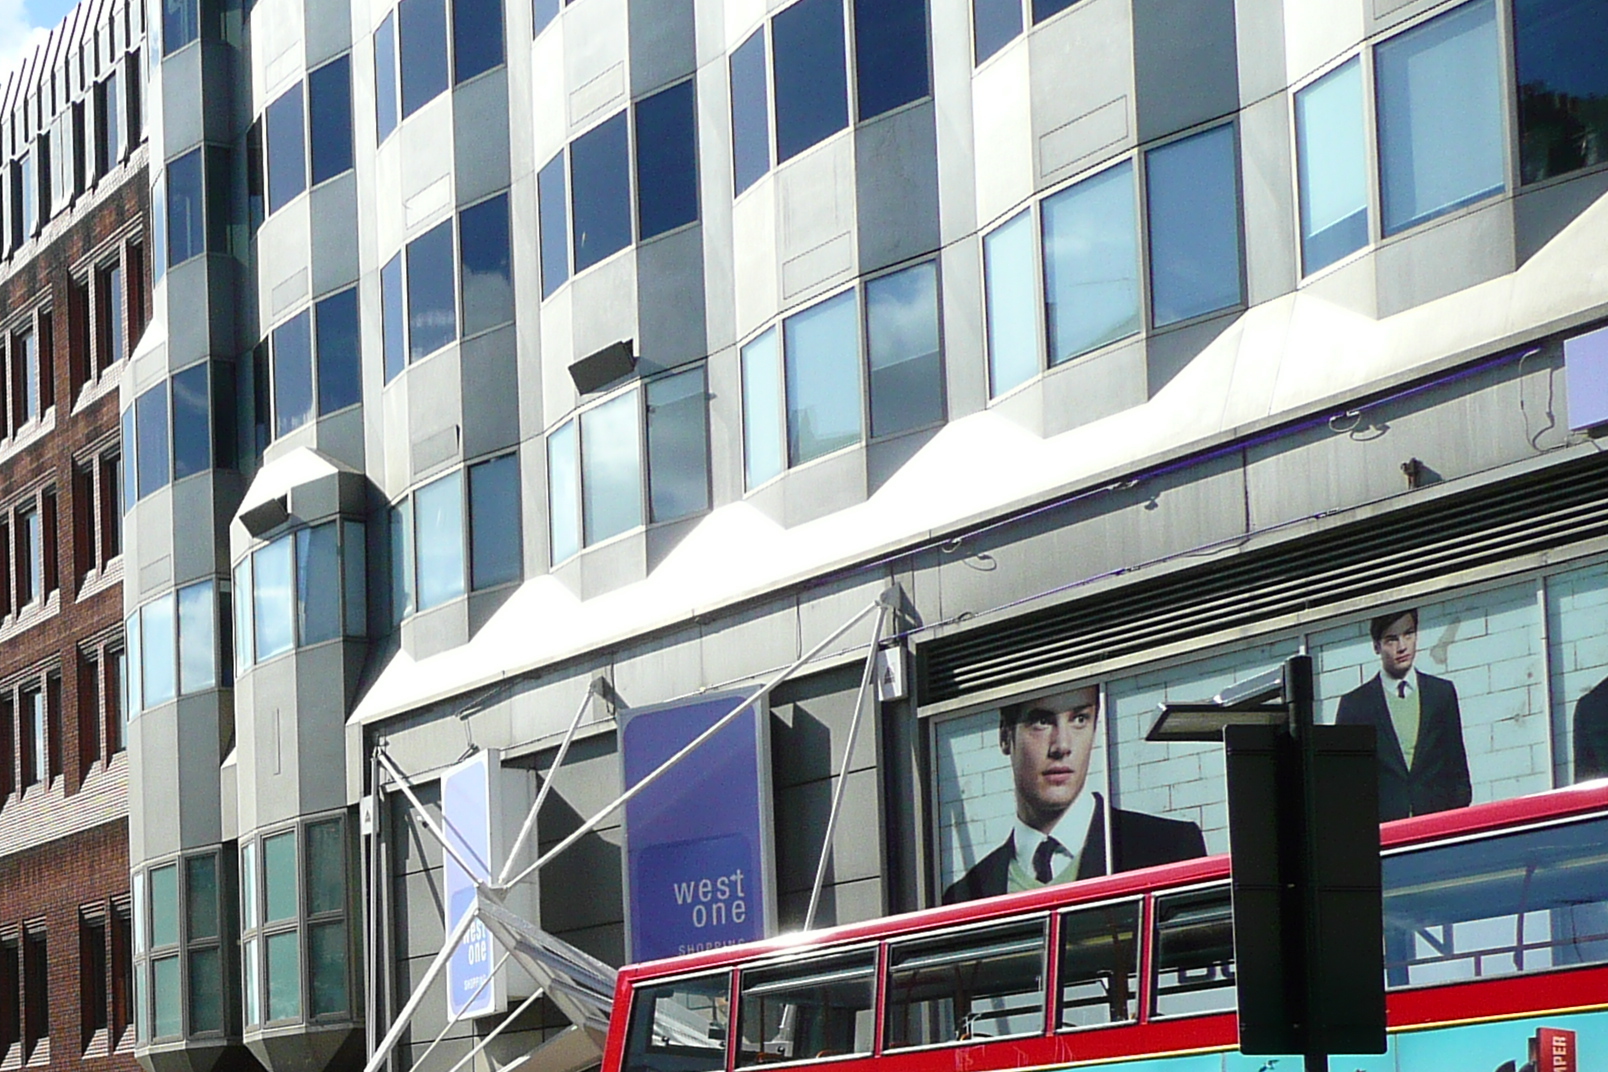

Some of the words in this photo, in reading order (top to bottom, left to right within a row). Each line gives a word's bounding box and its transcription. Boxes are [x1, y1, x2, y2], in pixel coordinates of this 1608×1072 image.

[674, 869, 745, 905] west
[693, 899, 746, 928] one
[468, 940, 487, 965] one
